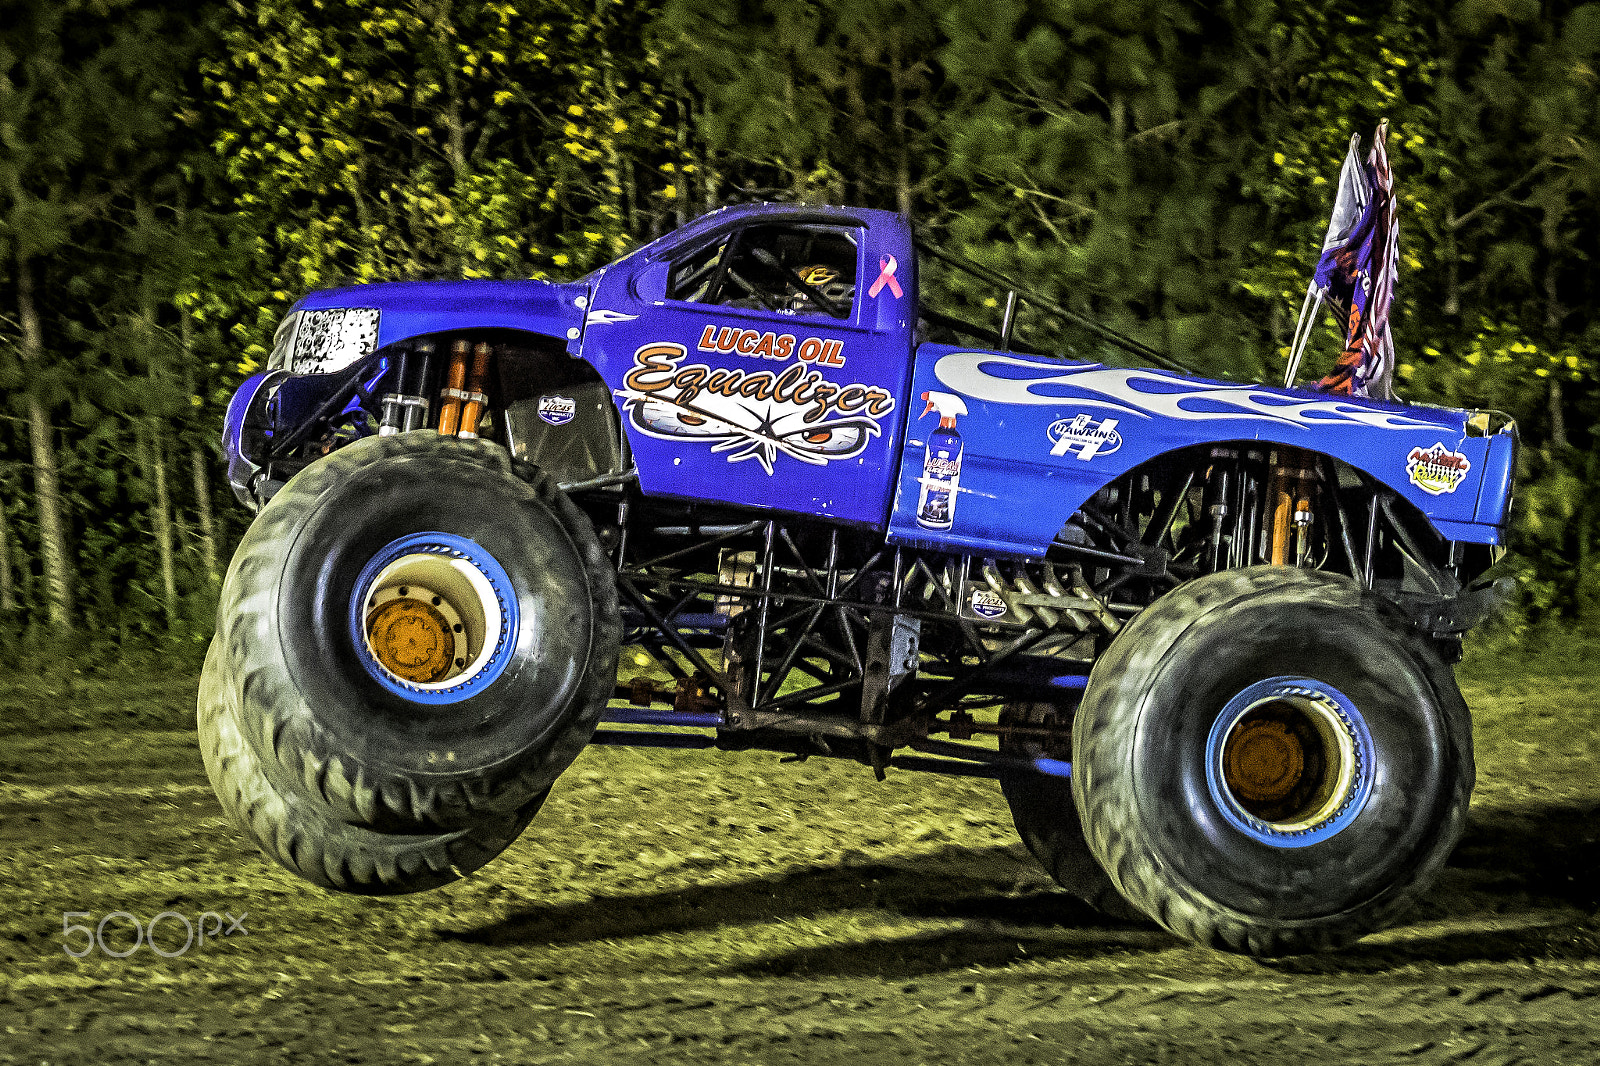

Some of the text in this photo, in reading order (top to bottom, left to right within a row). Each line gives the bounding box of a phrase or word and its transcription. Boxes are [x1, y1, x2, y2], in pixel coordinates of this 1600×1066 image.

[698, 324, 846, 368] LUCAS OIL
[623, 342, 896, 423] Equalizer
[1055, 423, 1117, 440] HAWKINS
[1413, 464, 1459, 489] Racing
